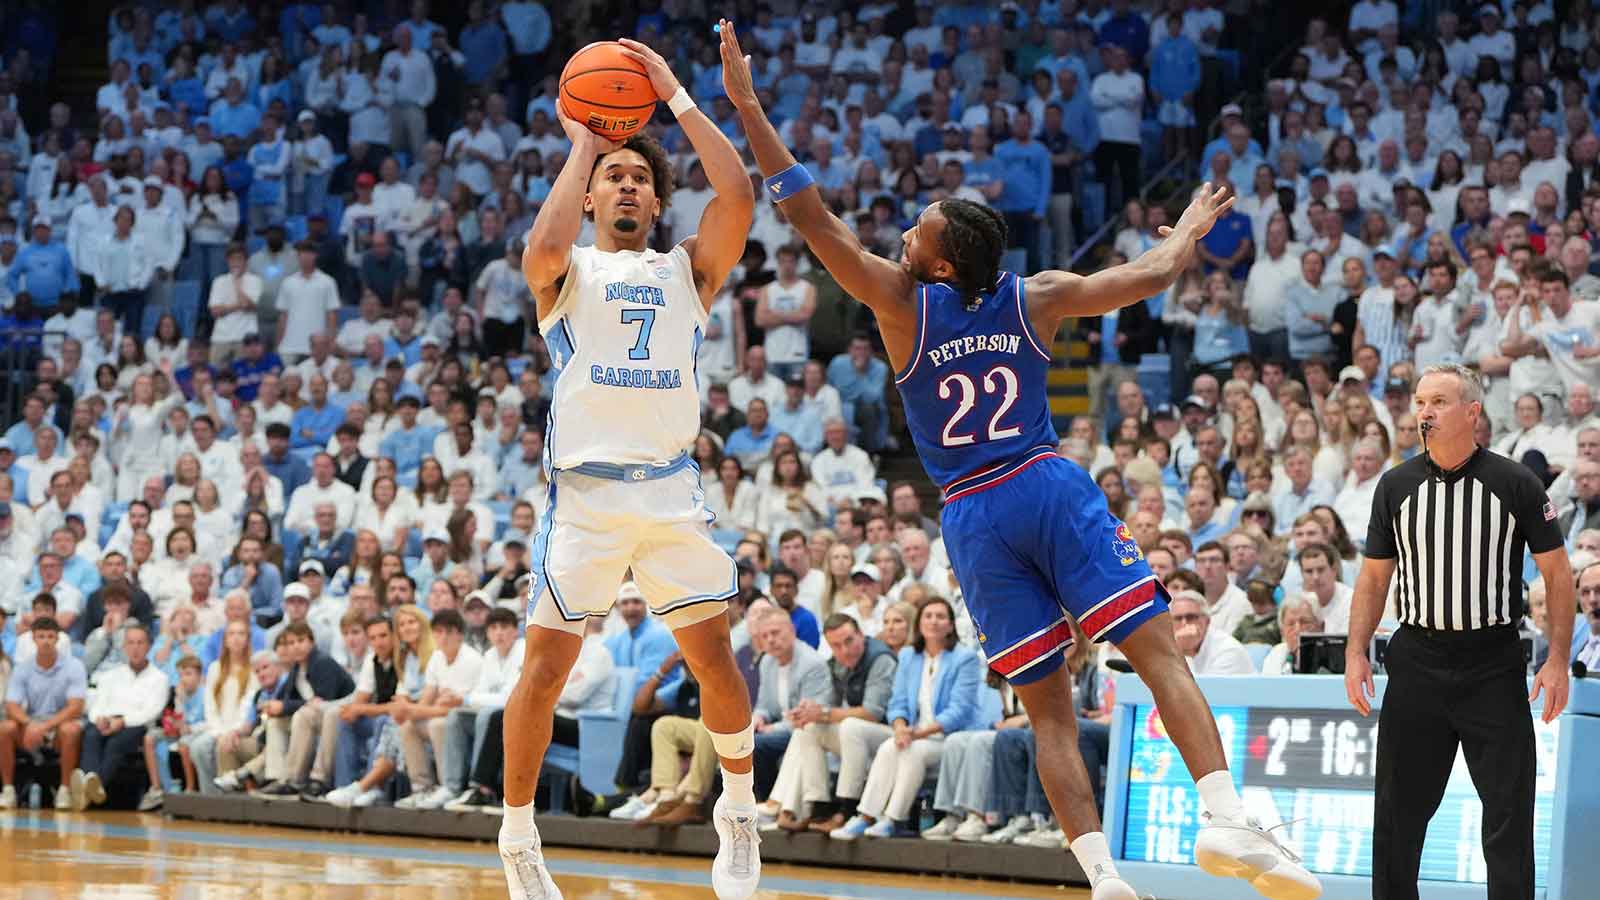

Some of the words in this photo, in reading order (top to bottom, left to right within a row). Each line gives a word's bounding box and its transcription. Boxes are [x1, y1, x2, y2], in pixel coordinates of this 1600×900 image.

[587, 112, 640, 131] ELITE
[605, 282, 665, 306] NORTH
[620, 308, 656, 361] 7
[927, 333, 1022, 367] PETERSON
[591, 365, 682, 389] CAROLNA
[938, 366, 1024, 447] 22
